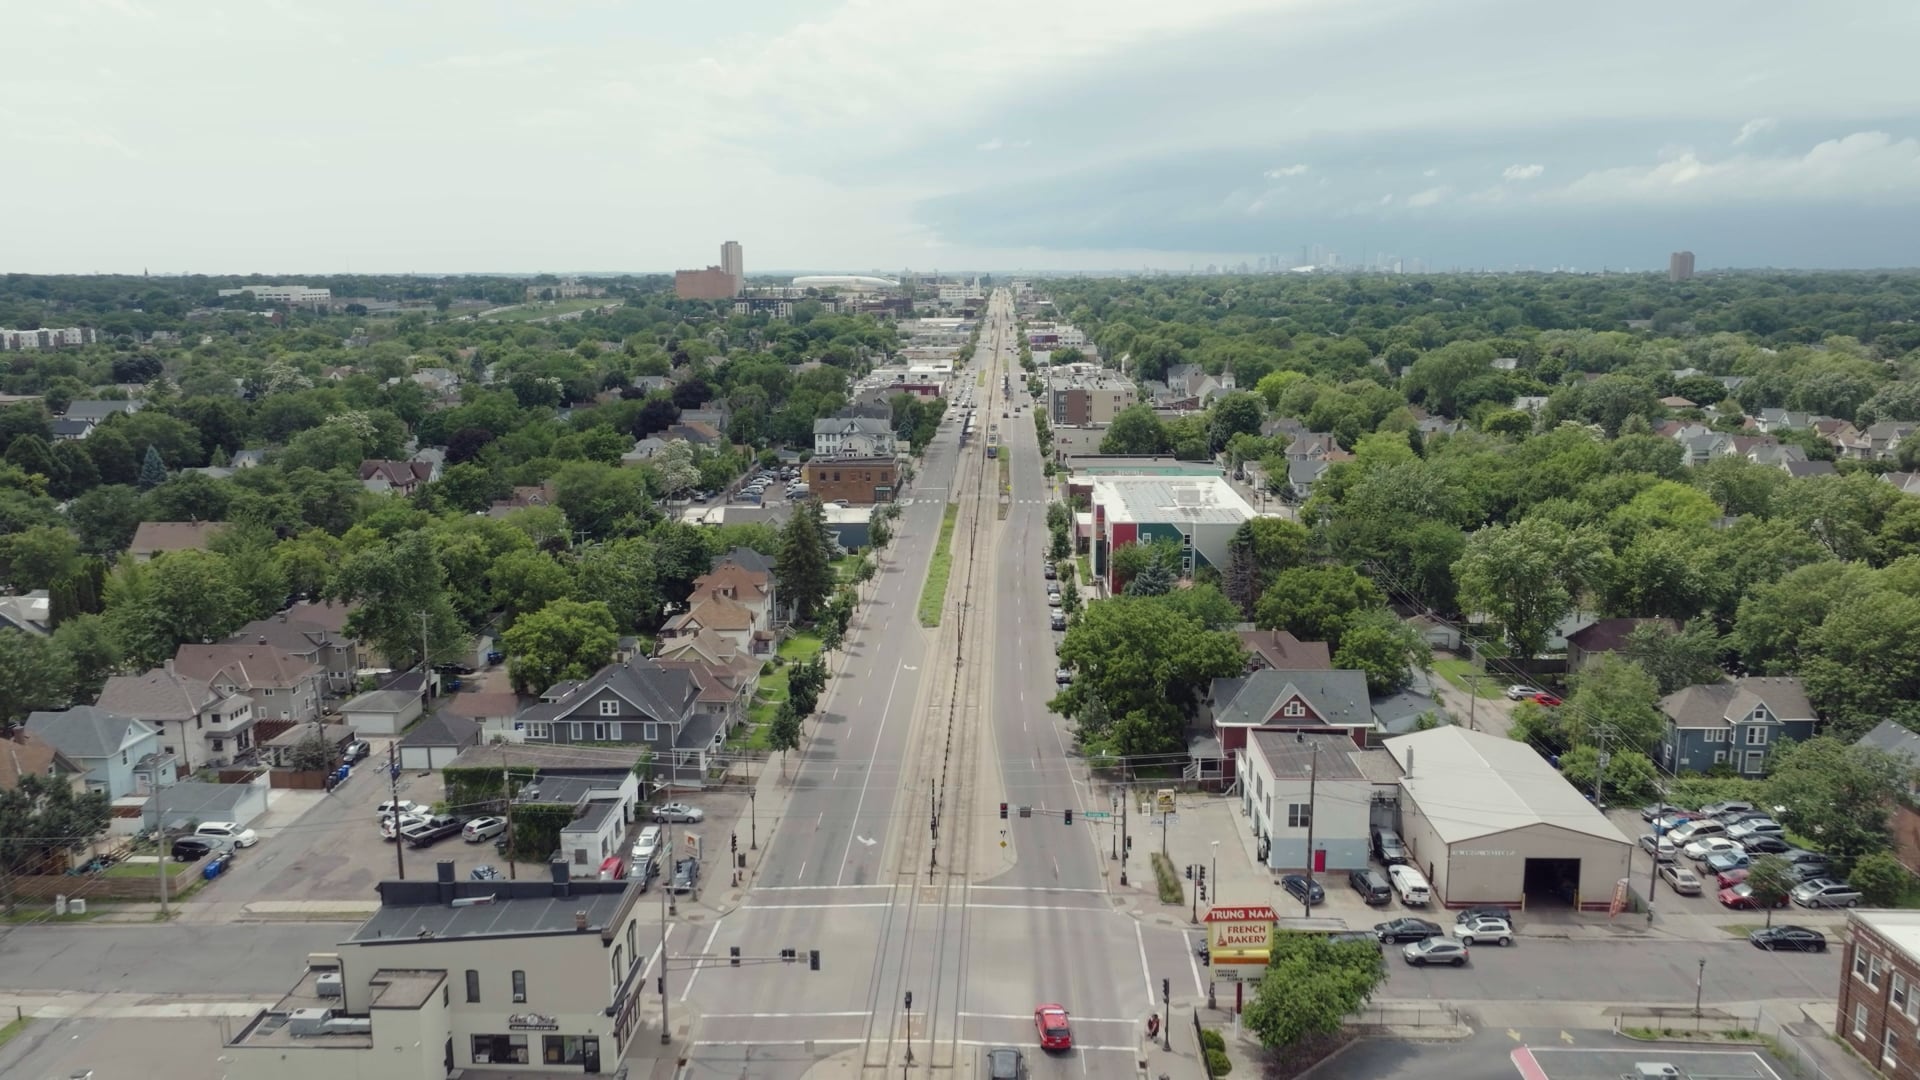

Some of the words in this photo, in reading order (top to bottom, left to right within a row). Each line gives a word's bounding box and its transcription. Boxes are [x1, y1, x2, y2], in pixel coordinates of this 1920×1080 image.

[1211, 910, 1245, 919] TRUNG
[1248, 909, 1274, 918] NAM
[1227, 926, 1266, 934] FRENCH
[1227, 936, 1267, 944] BAKERY
